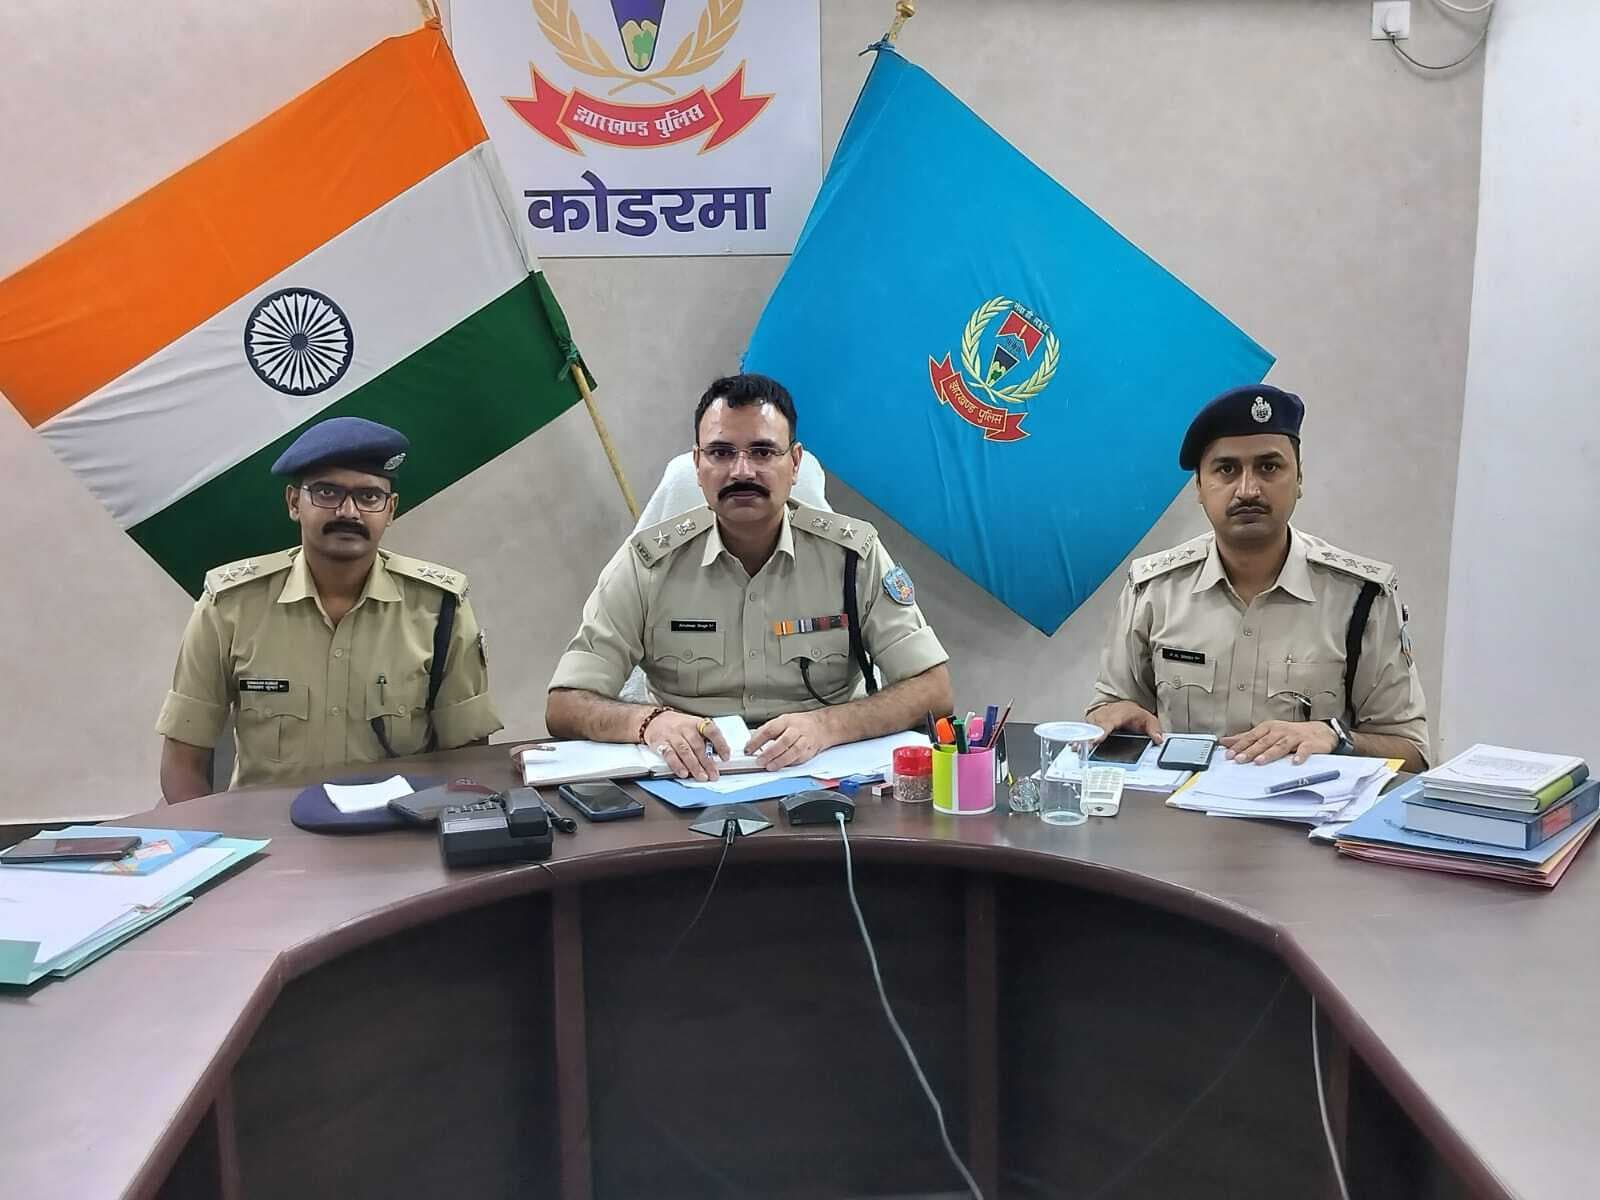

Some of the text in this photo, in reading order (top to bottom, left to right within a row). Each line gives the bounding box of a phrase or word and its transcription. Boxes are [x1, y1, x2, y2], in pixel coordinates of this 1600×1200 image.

[573, 103, 705, 138] झारखण्ड पुलिस
[524, 170, 772, 237] कोडरमा
[978, 408, 1004, 424] पुलिस
